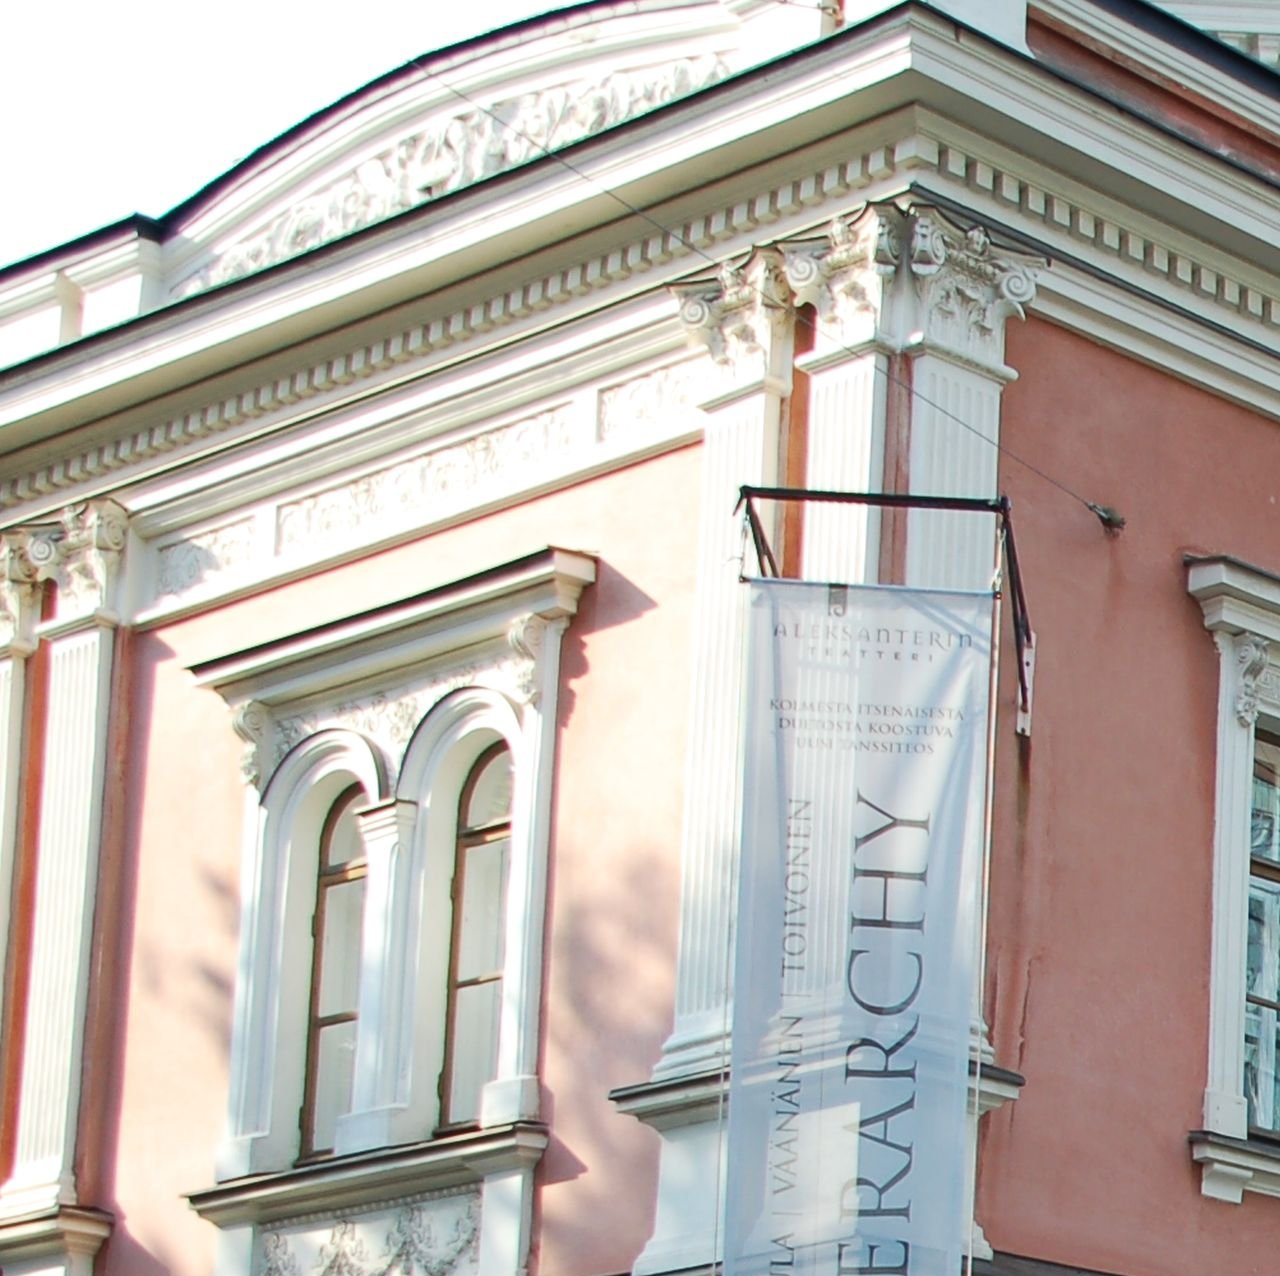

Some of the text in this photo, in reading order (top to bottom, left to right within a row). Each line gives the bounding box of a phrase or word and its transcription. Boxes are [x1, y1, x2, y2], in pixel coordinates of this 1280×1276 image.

[808, 646, 933, 662] TEATTERI
[769, 699, 853, 714] KOLMESTA
[868, 723, 953, 738] KOOSTUVA
[780, 798, 811, 978] TOIVONEN
[768, 1016, 803, 1195] VÄÄNÄNEN
